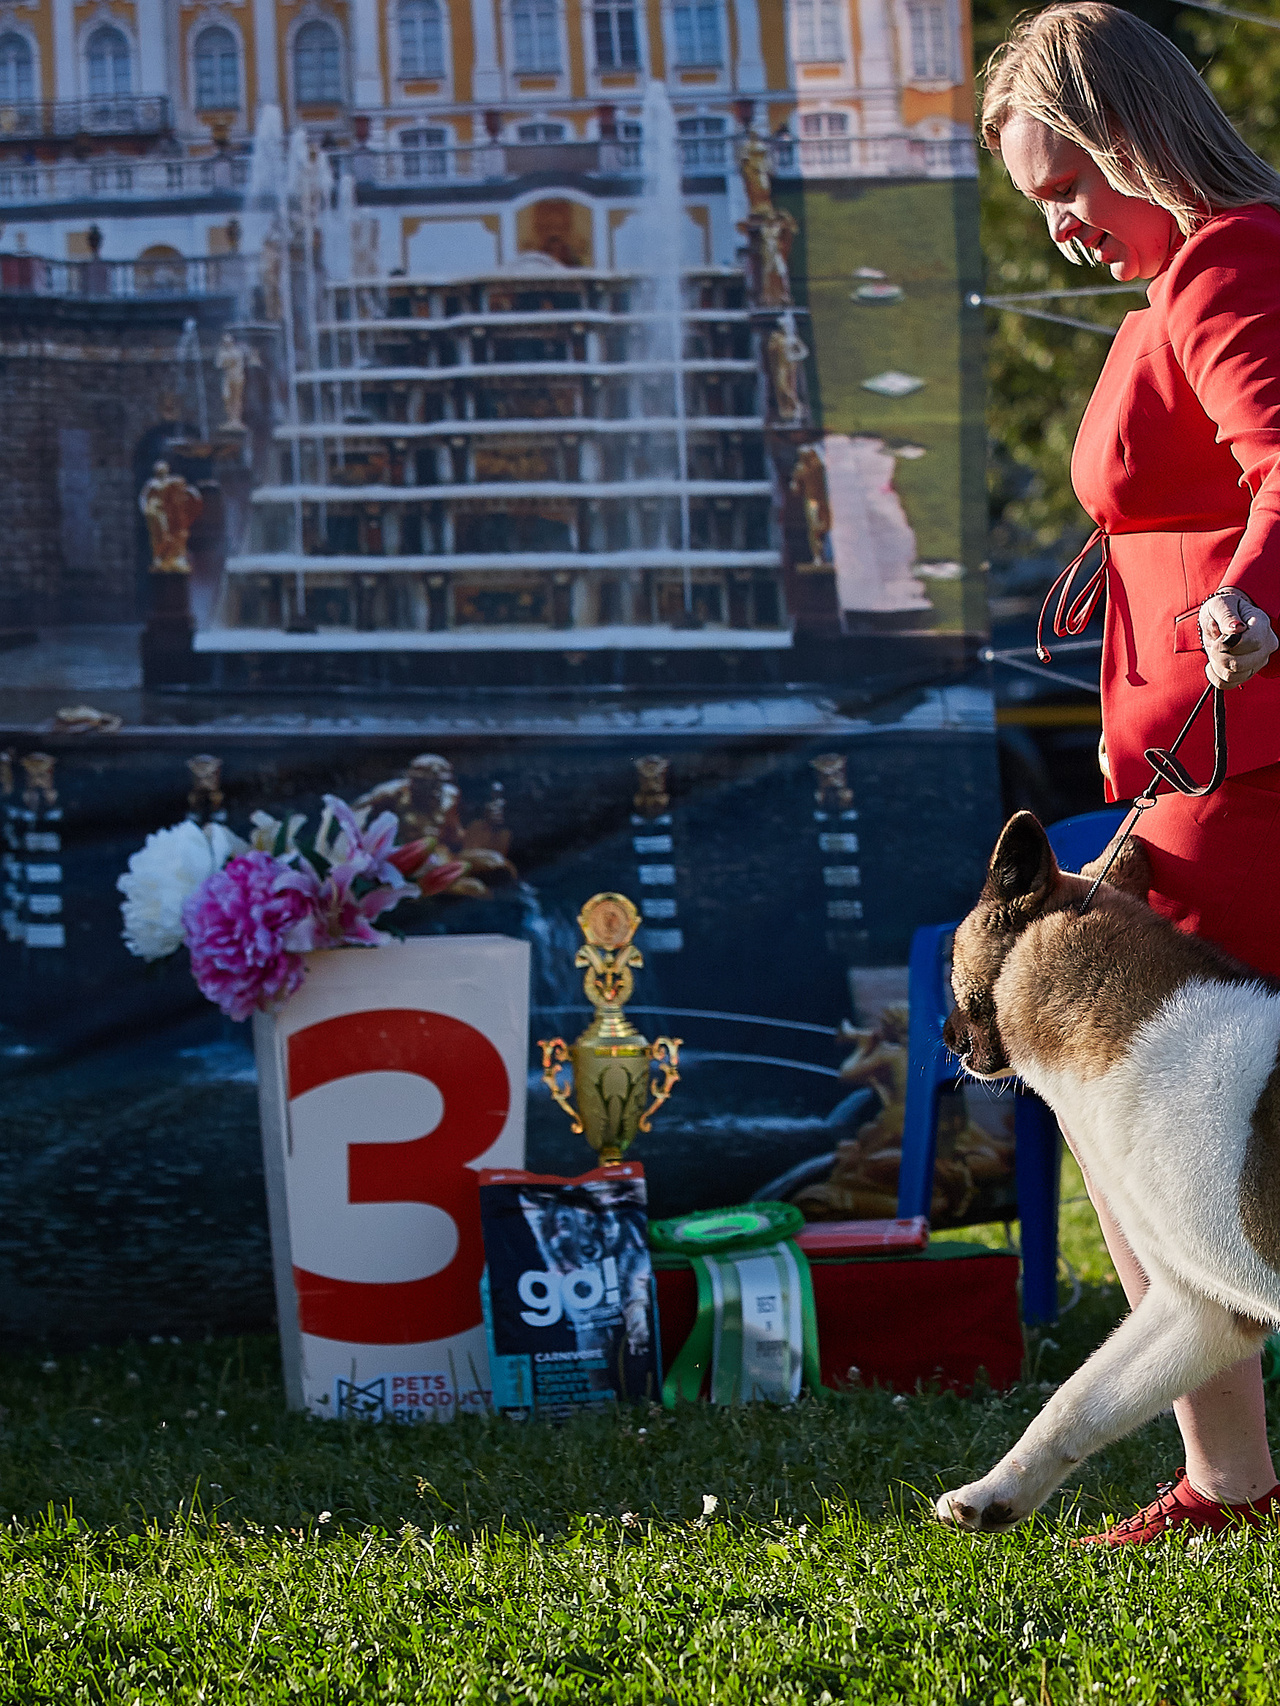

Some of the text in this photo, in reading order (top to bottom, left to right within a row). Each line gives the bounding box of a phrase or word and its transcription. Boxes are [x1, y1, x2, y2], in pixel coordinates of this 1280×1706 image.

[288, 1008, 510, 1345] 3
[518, 1256, 620, 1327] go!
[393, 1376, 445, 1390] PETS
